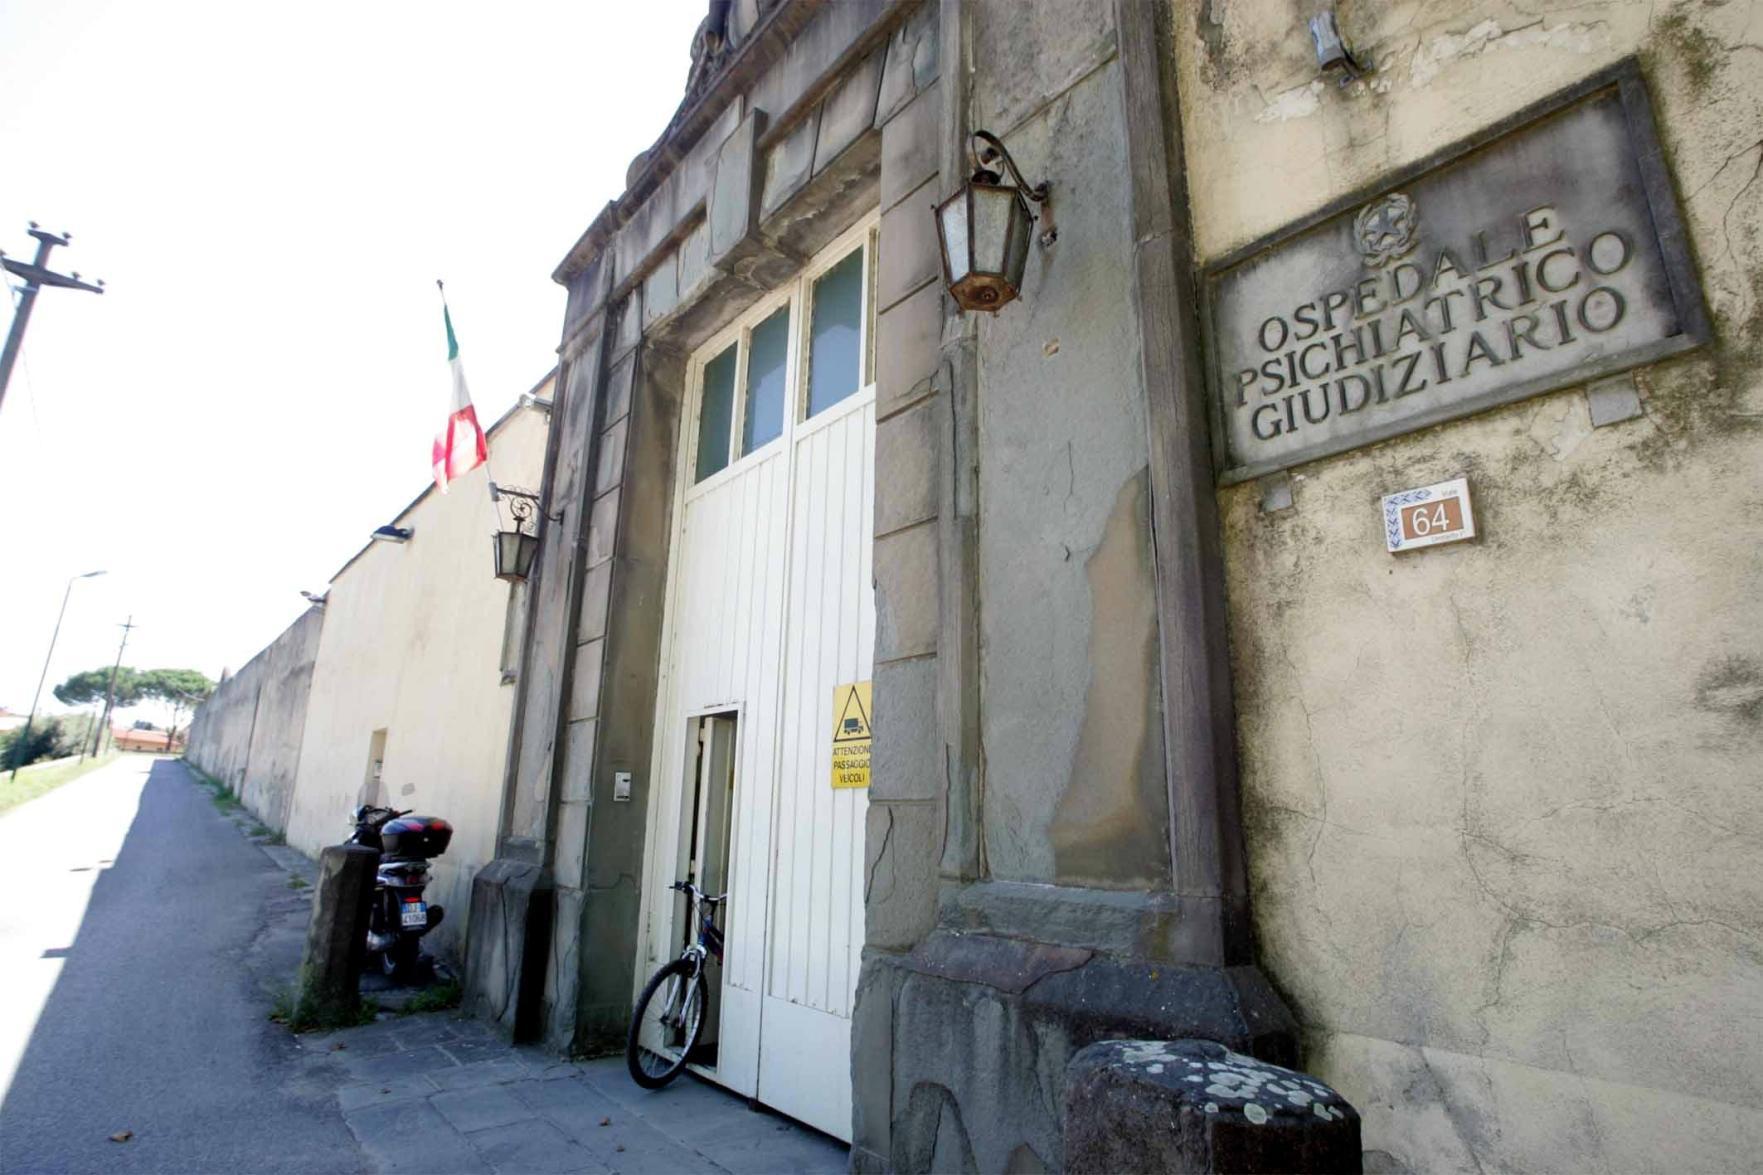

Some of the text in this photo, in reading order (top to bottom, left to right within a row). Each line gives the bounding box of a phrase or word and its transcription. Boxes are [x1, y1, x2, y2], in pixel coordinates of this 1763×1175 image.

[1234, 230, 1634, 410] PSICHIATRICO
[1258, 204, 1567, 353] OSPEDALE
[1251, 286, 1627, 441] GIUDIZIARIO
[1412, 502, 1451, 536] 64
[839, 772, 866, 784] VEICOLI
